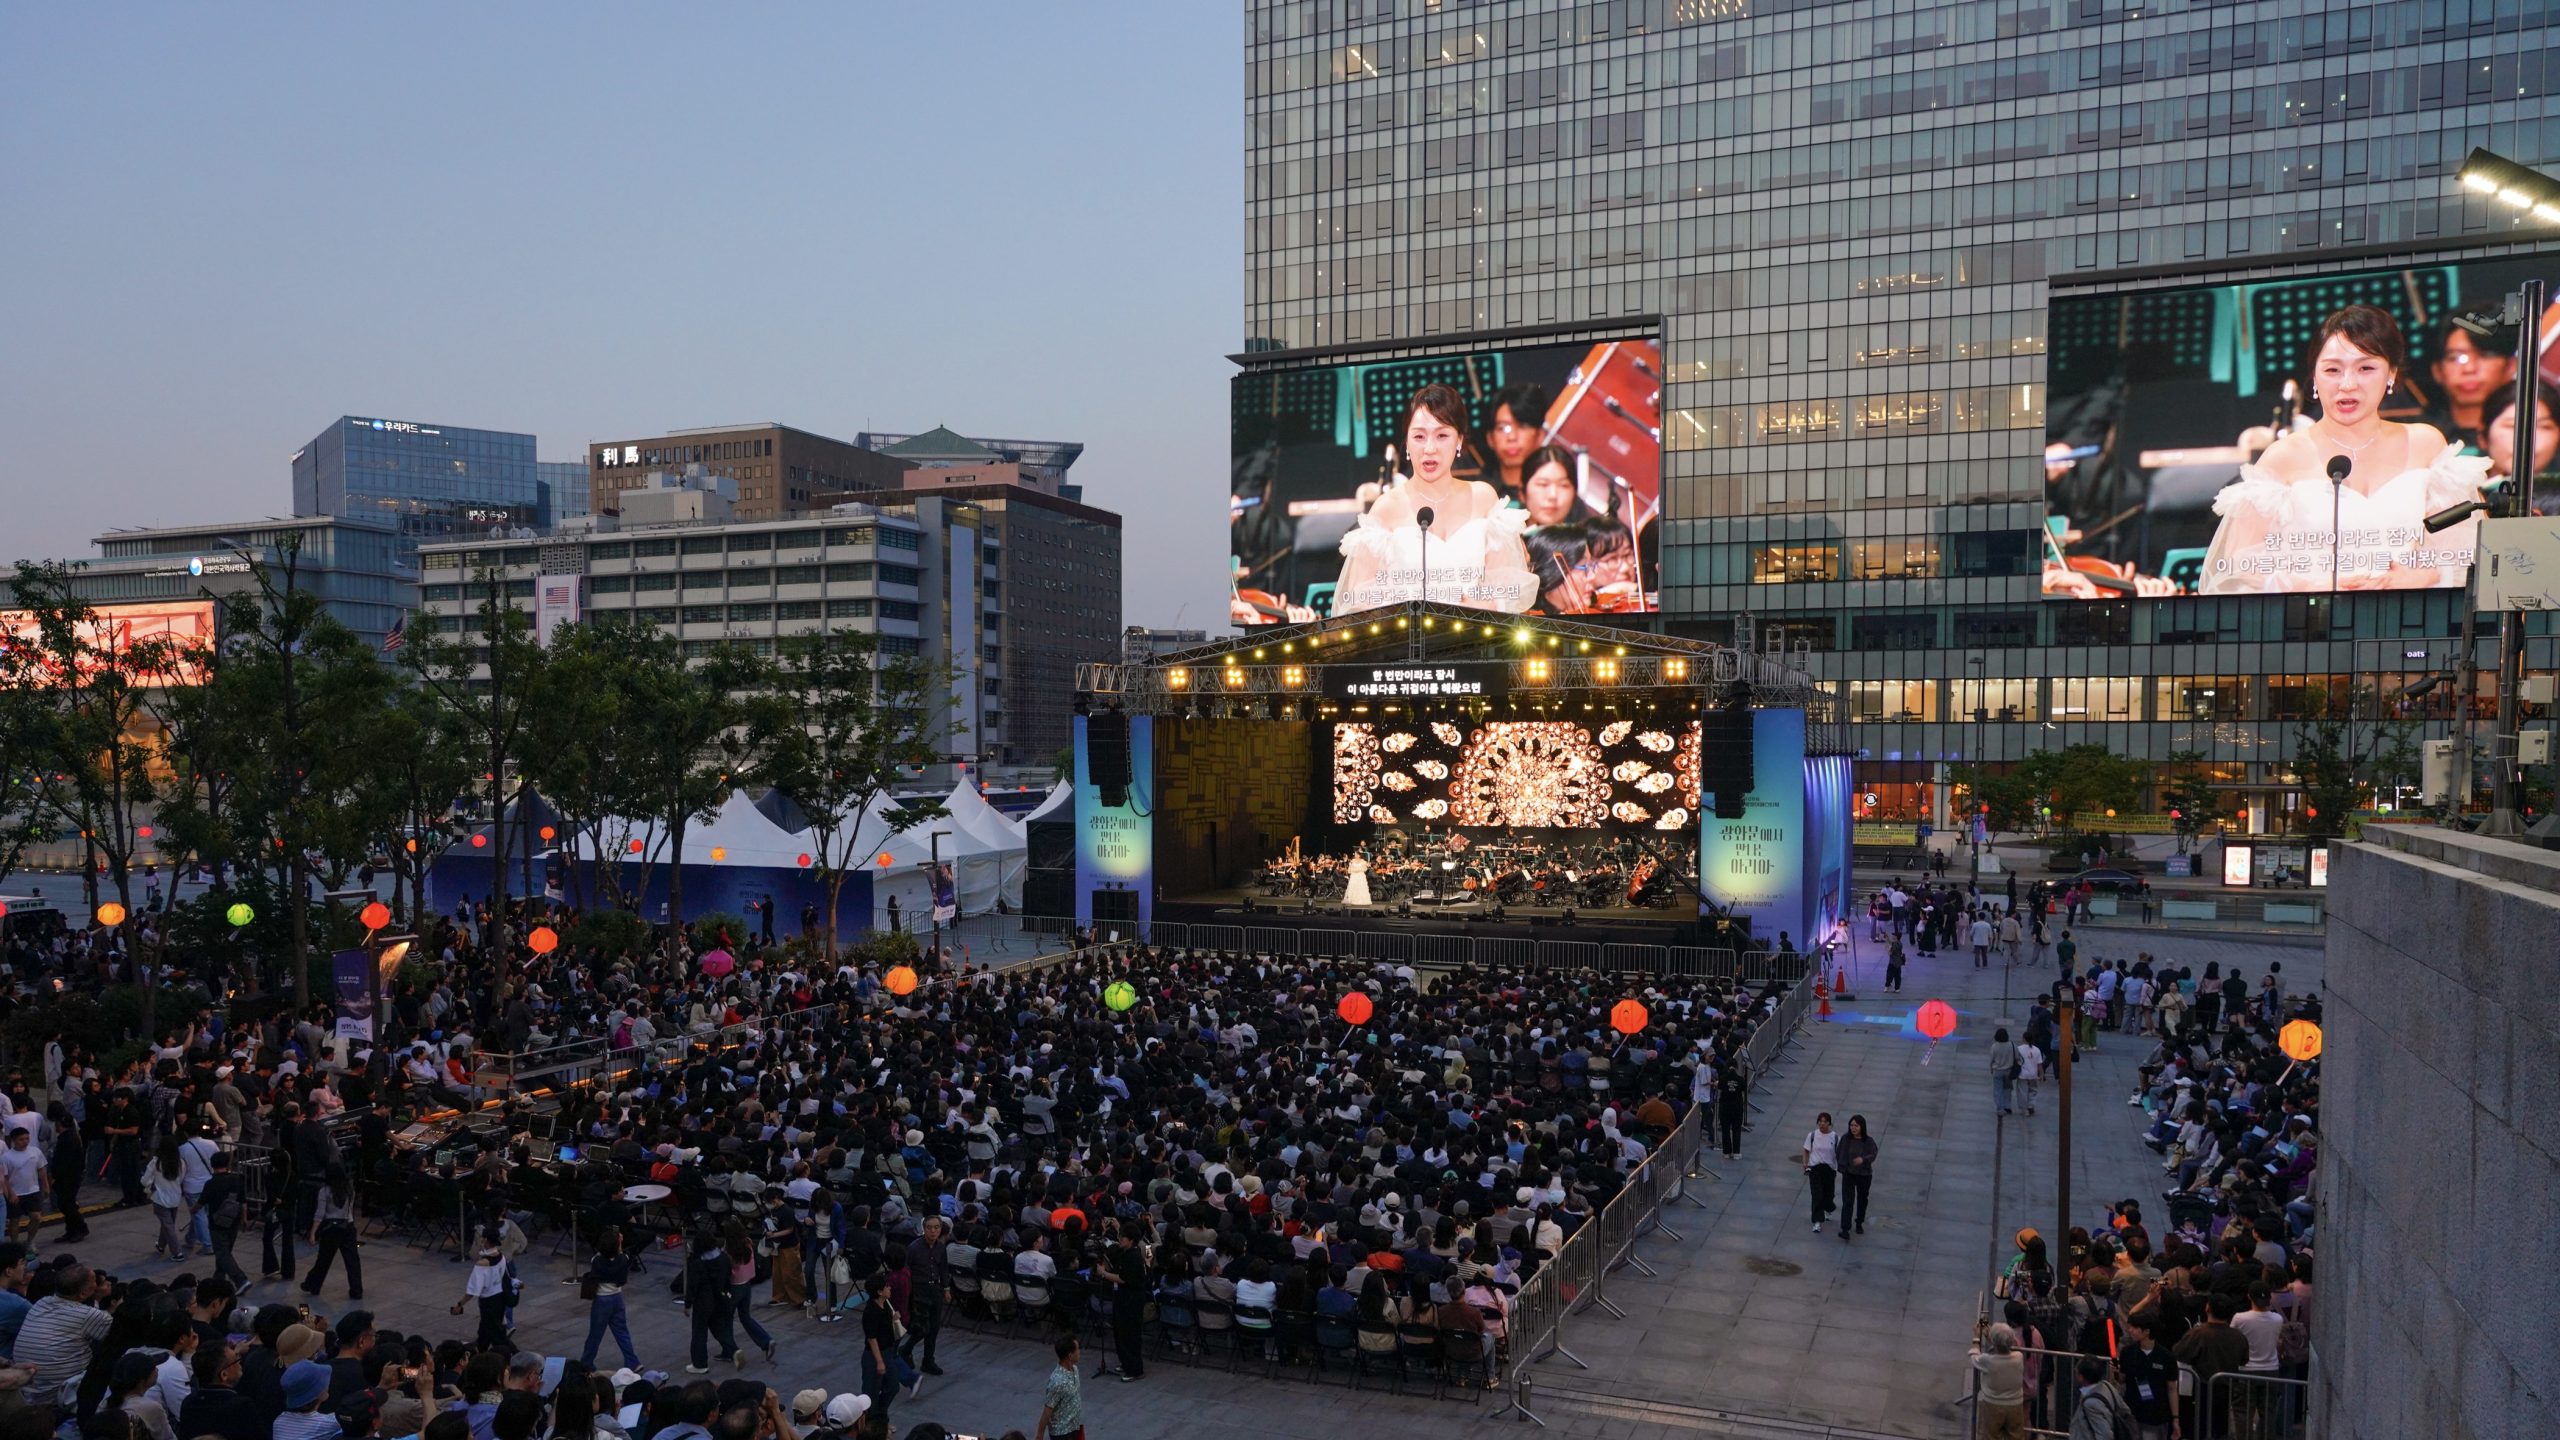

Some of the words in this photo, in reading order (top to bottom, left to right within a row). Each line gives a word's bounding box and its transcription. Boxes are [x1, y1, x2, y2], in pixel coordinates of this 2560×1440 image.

[385, 421, 418, 433] 우리카드
[603, 446, 639, 465] 利馬
[2264, 532, 2282, 551] 한
[2288, 530, 2380, 550] 번만이라도
[2387, 527, 2425, 546] 잠시
[2216, 557, 2234, 574] 이
[2239, 555, 2312, 574] 아름다운
[2318, 551, 2393, 572] 귀걸이를
[2399, 548, 2475, 569] 해봤으면
[1375, 569, 1388, 585] 한
[1392, 567, 1456, 584] 번만이라도
[1459, 566, 1485, 581] 잠시
[1343, 591, 1355, 605] 이
[1359, 588, 1408, 604] 아름다운
[1413, 586, 1463, 601] 귀걸이를
[1467, 584, 1520, 600] 해봤으면
[2406, 650, 2425, 658] oats
[1373, 670, 1382, 681] 한
[1385, 670, 1433, 681] 번만이라도
[1436, 669, 1455, 680] 잠시
[1347, 684, 1357, 695] 이
[1360, 684, 1397, 695] 아름다운
[1400, 683, 1438, 694] 귀걸이를
[1441, 682, 1481, 694] 해봤으면
[1089, 816, 1136, 830] 광화문에서
[1720, 825, 1783, 842] 광화문에서
[1097, 845, 1130, 858] 아리아
[1735, 843, 1764, 856] 만나는
[1730, 859, 1775, 875] 아리아
